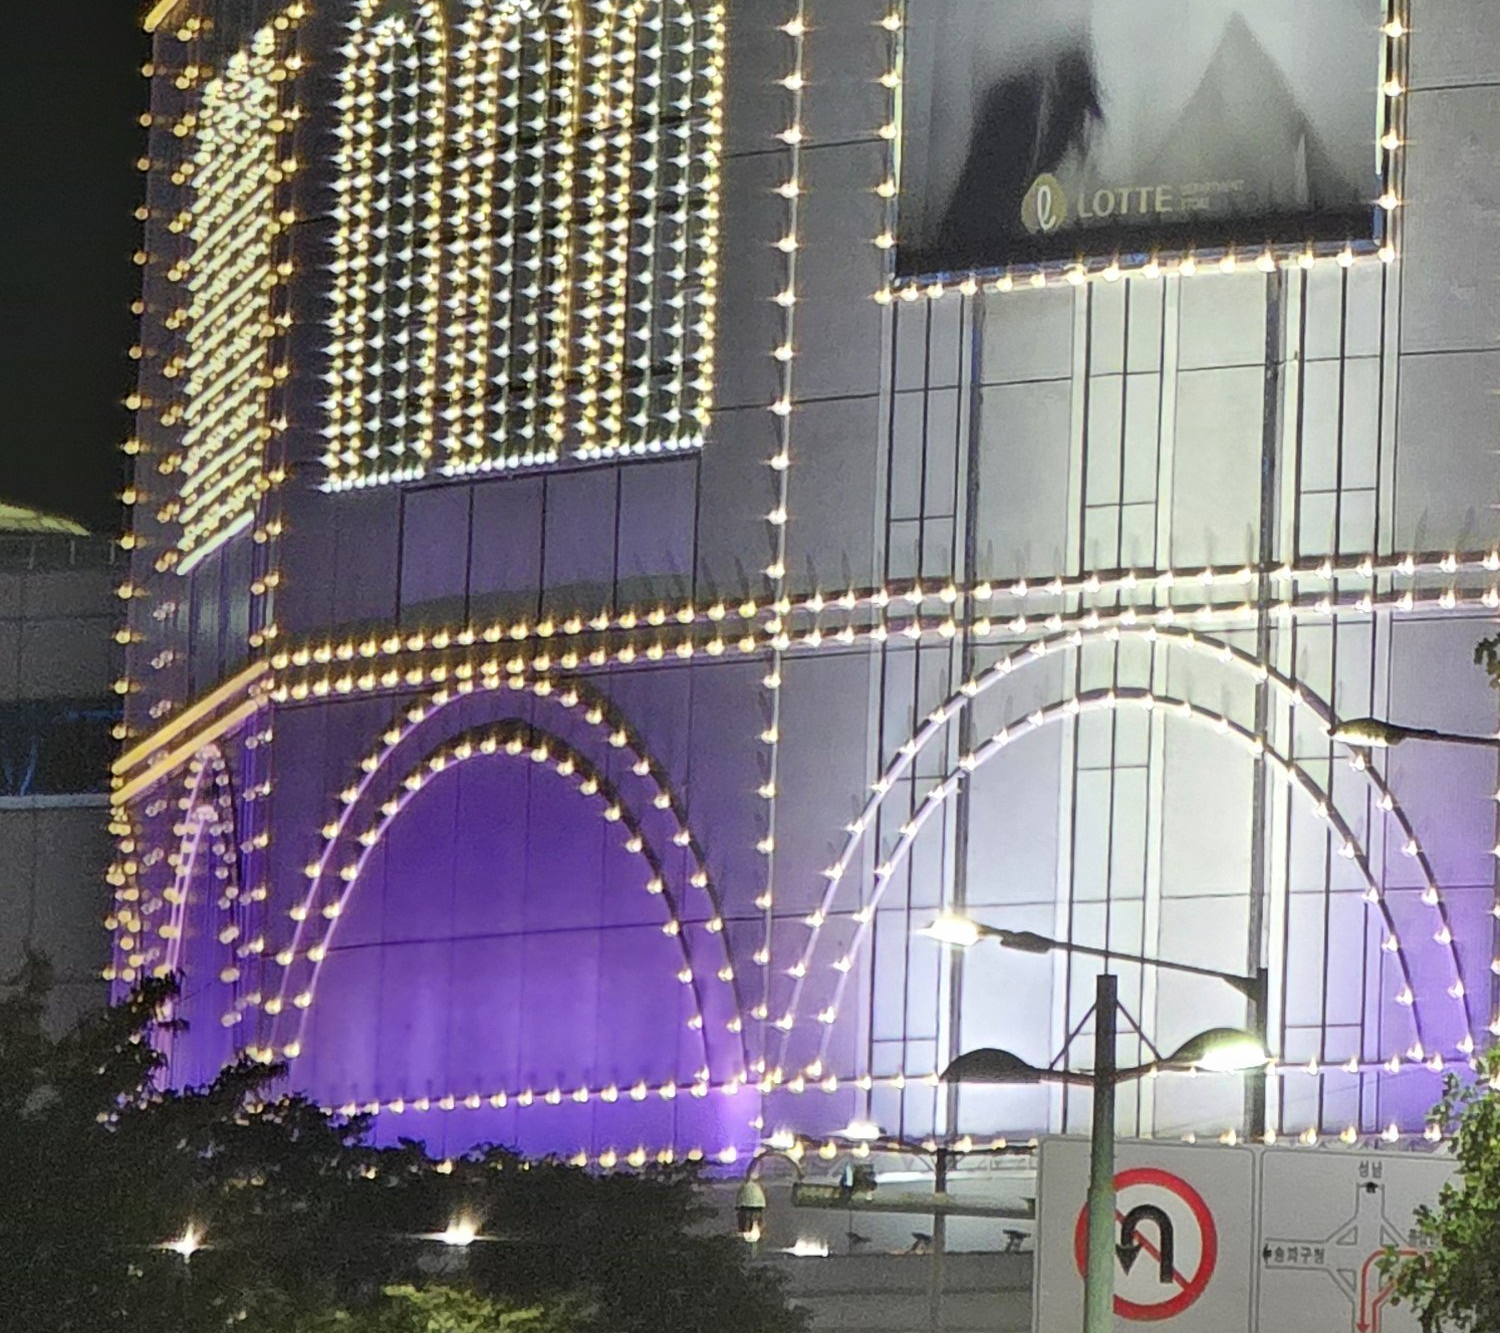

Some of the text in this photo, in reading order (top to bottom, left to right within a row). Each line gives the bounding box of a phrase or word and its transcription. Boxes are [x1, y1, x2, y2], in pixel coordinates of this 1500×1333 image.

[1077, 185, 1174, 219] LOTTE
[1358, 1160, 1384, 1179] 성남
[1273, 1246, 1325, 1265] 송파구청
